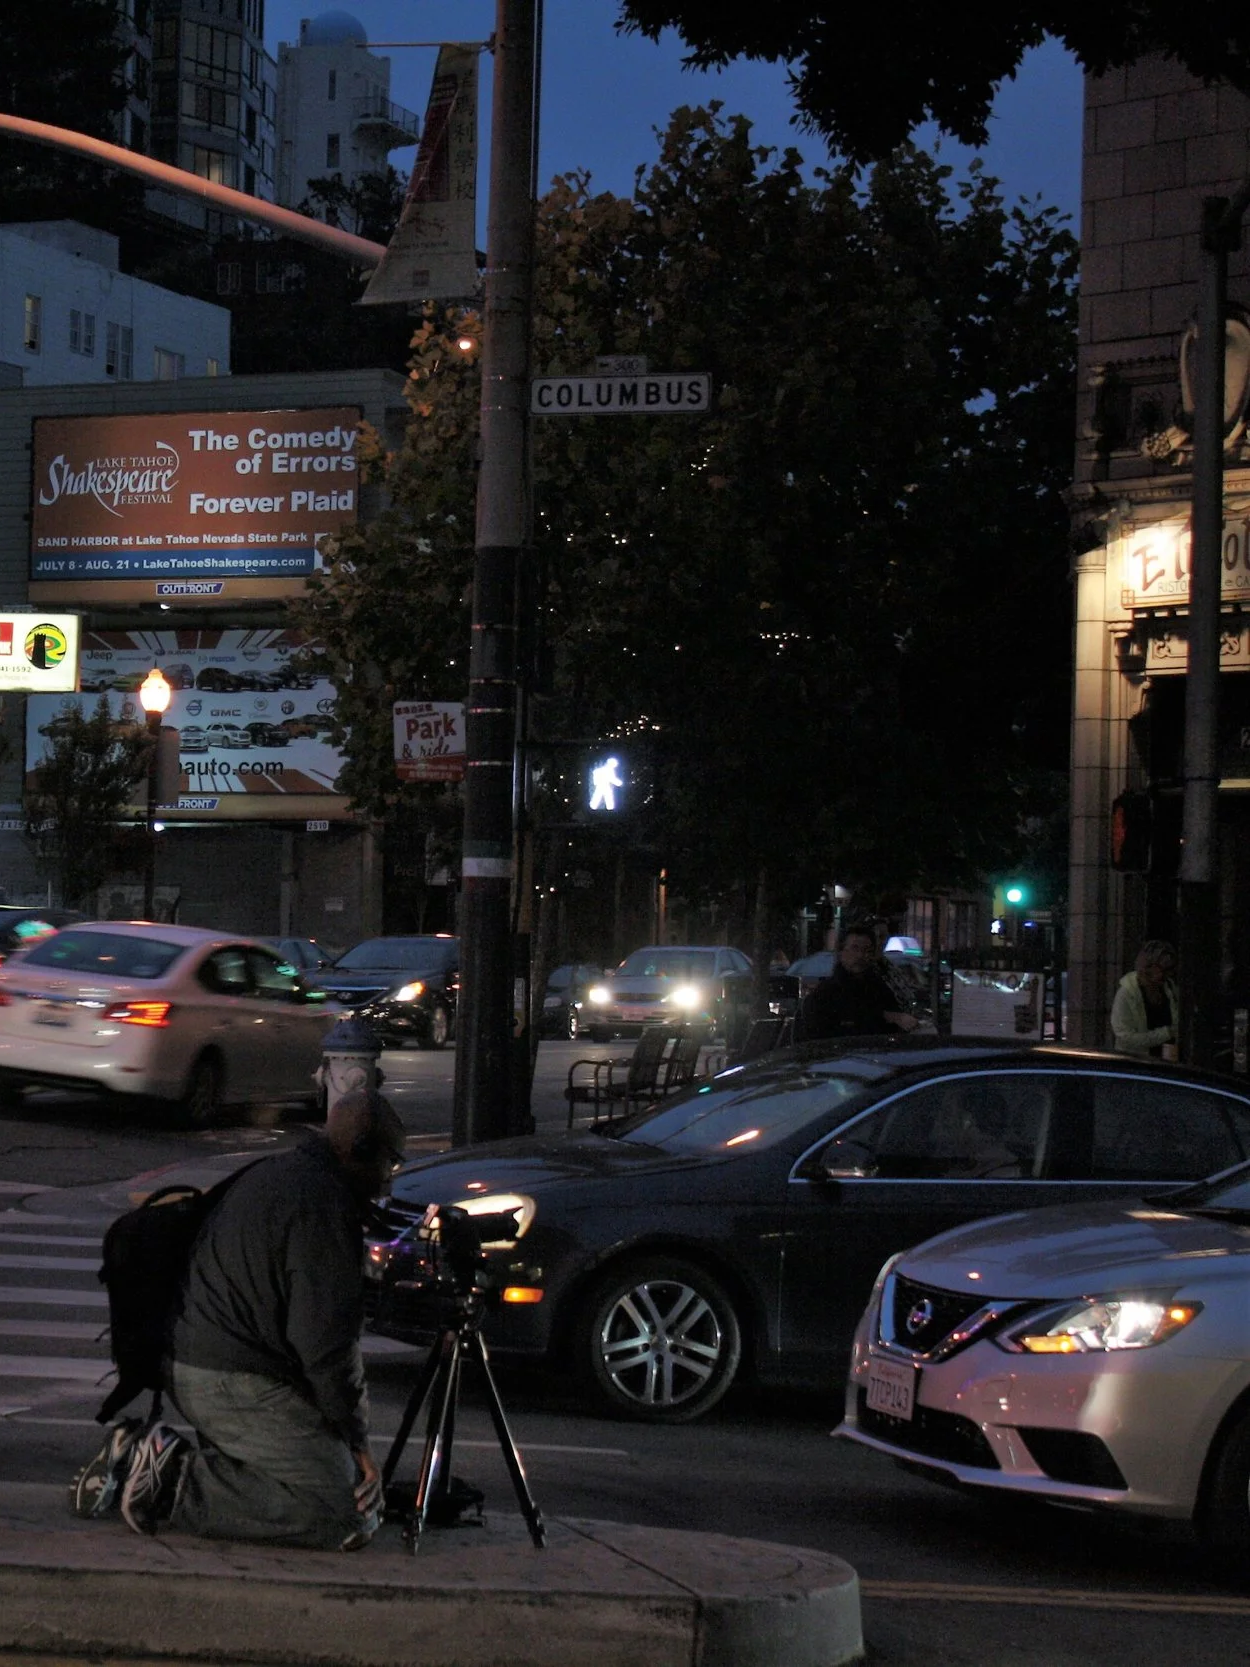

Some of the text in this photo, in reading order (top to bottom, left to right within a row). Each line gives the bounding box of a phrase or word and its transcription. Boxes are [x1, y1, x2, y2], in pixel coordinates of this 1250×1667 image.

[537, 381, 702, 407] COLUMBUS
[189, 426, 356, 451] The Comedy
[96, 455, 174, 468] LAKE TAHOE
[235, 453, 355, 474] of Errors
[39, 454, 178, 507] Shakespeare
[121, 493, 172, 504] FESTIVAL
[190, 490, 353, 514] Forever Plaid
[37, 531, 307, 547] SAND HARBOR at Lake Tahoe Nevada State Park
[36, 561, 64, 571] JULY
[68, 560, 75, 570] 8
[85, 559, 112, 570] AUG.
[116, 558, 129, 569] 21
[143, 555, 306, 570] LakeTahoeShakespeare.com
[162, 584, 216, 594] OUTFRONT
[86, 650, 112, 661] Jeep
[210, 709, 241, 717] GMC
[406, 712, 457, 740] Park
[403, 735, 450, 763] & ride
[158, 799, 211, 809] FRONT
[308, 821, 328, 830] 2510
